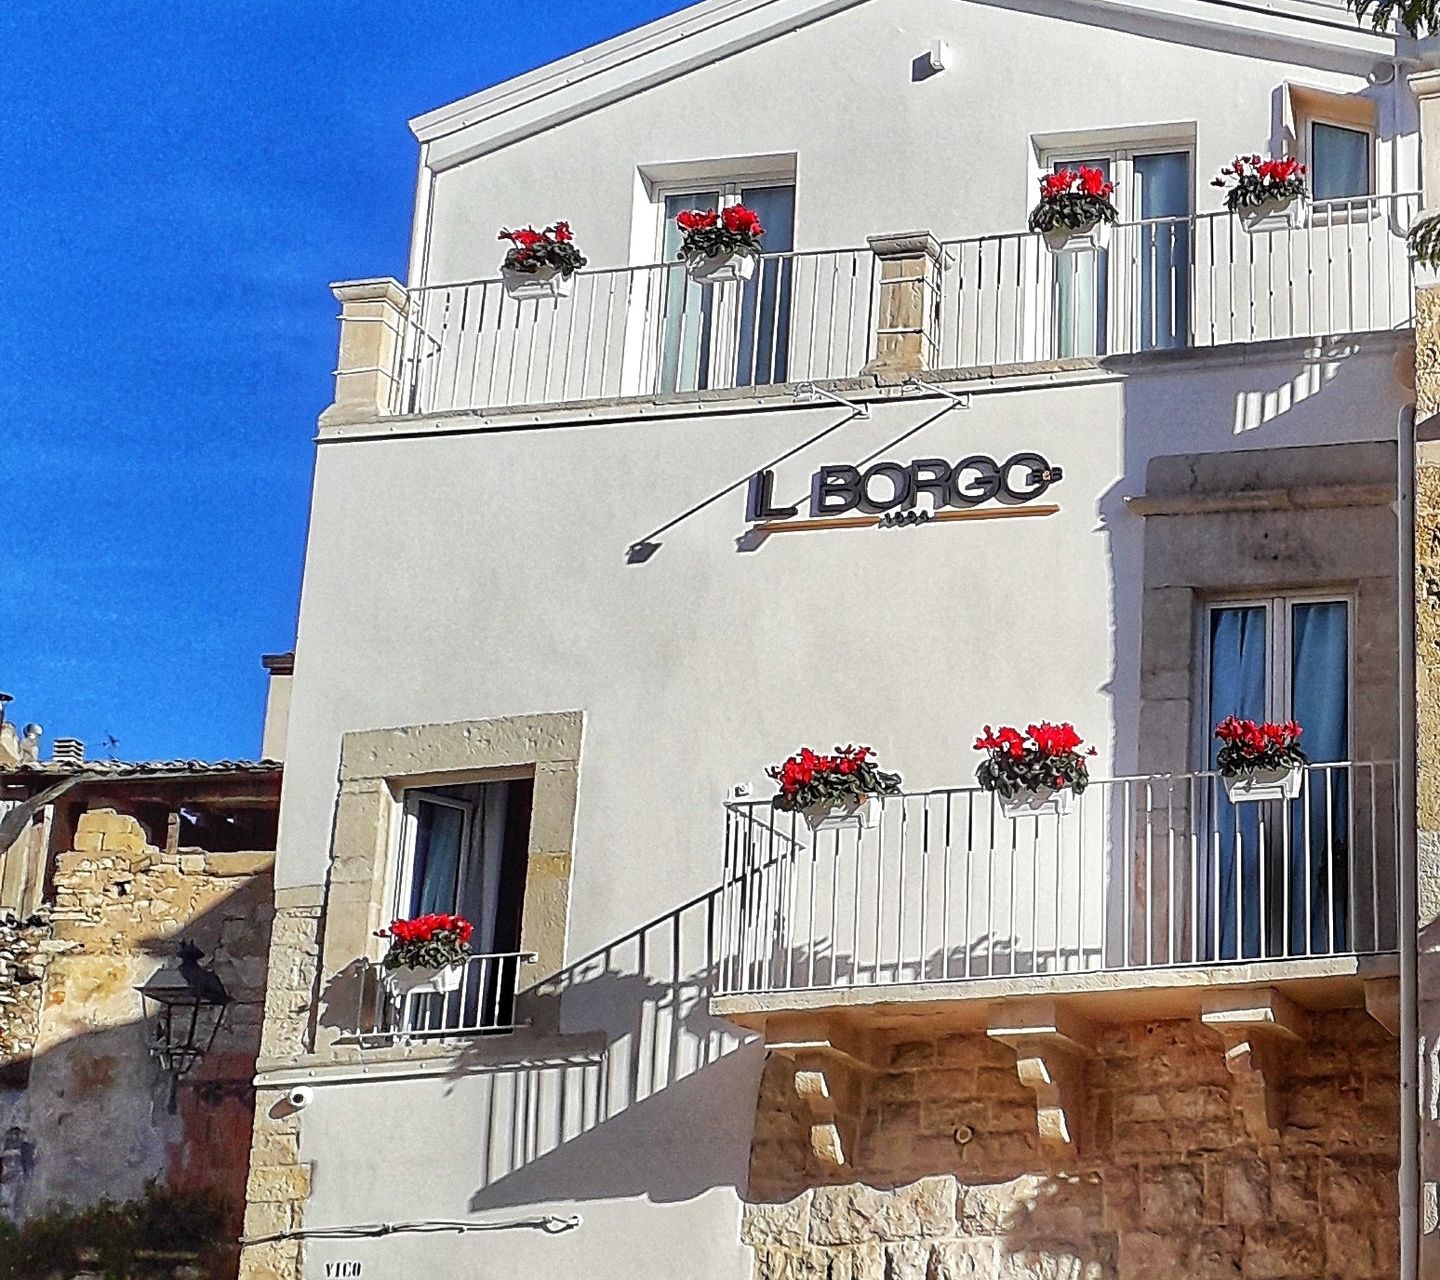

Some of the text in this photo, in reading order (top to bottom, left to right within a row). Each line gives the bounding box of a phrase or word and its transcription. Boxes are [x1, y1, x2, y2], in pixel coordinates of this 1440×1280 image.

[747, 469, 799, 520] IL
[811, 452, 1051, 516] BORGO
[325, 1261, 362, 1278] VICO
